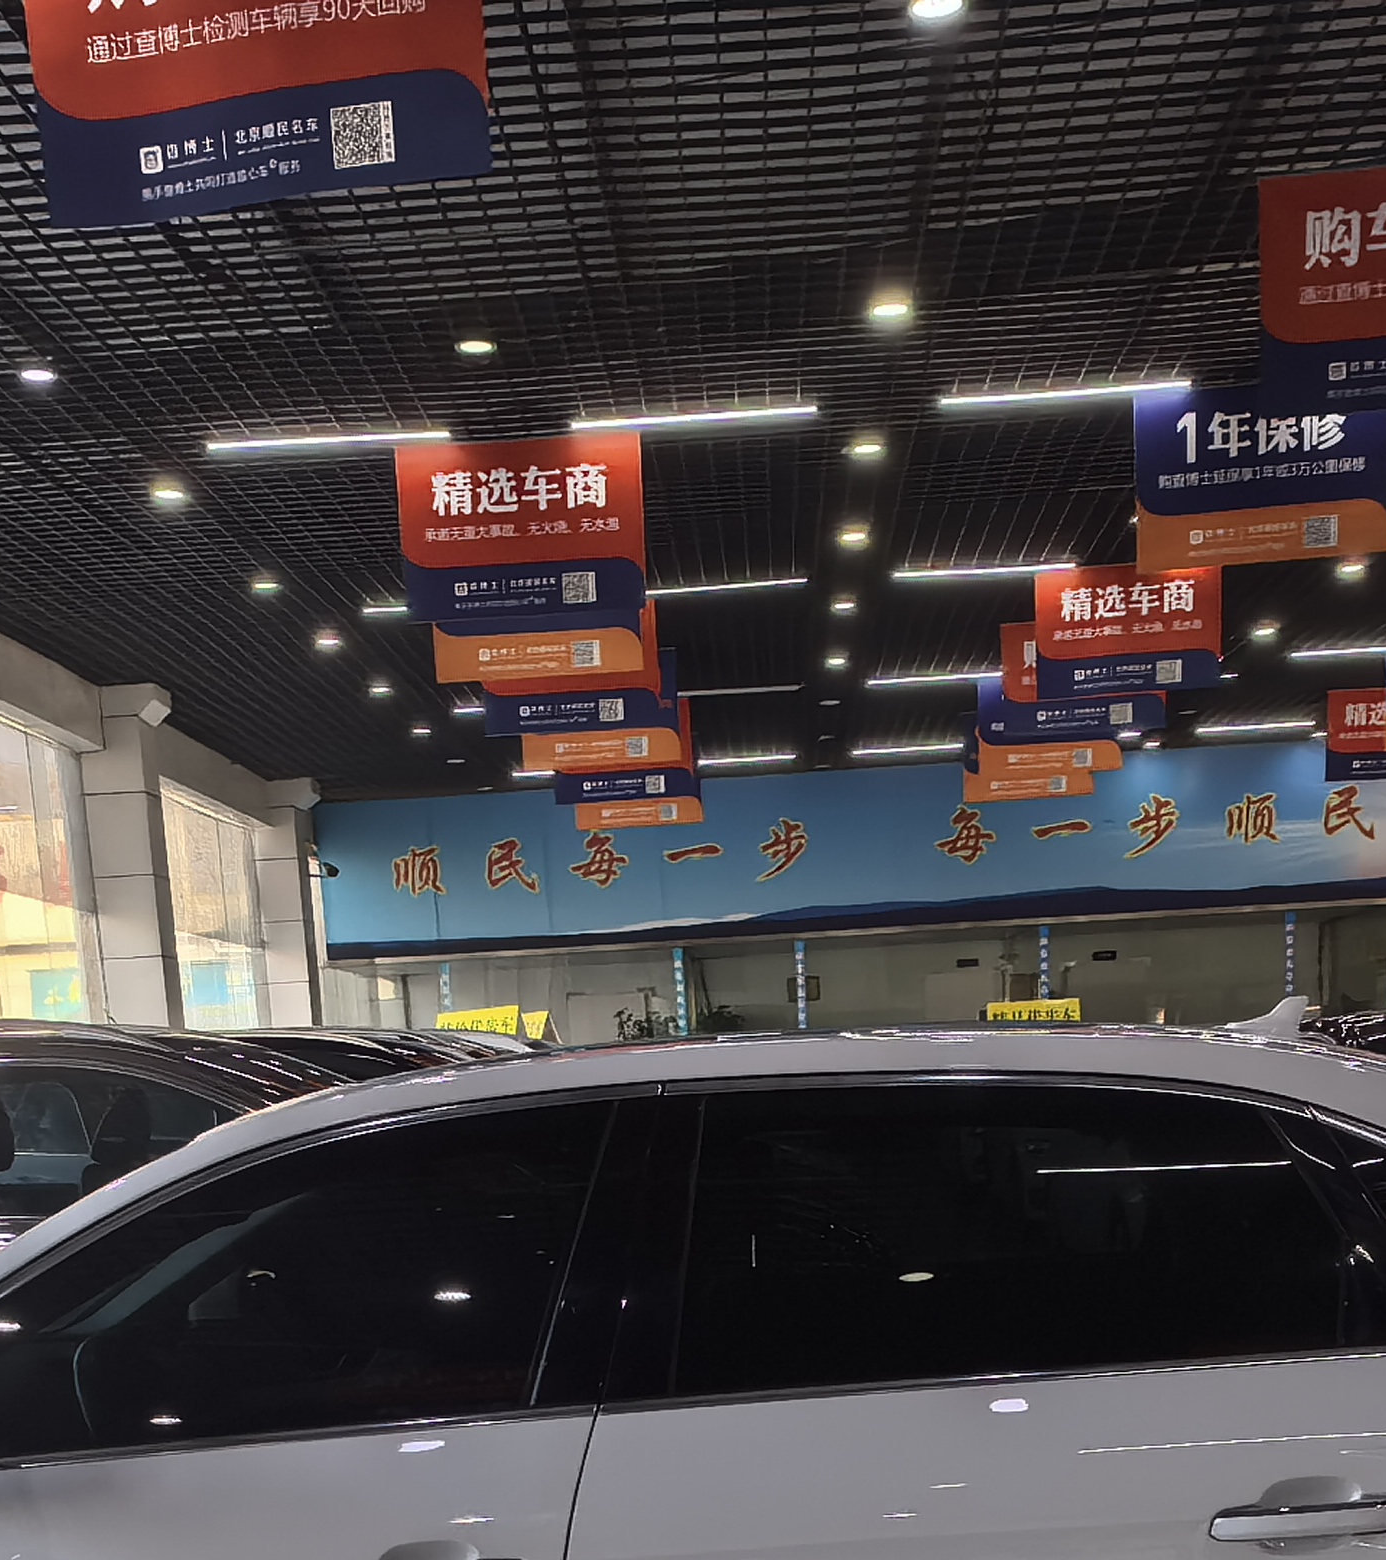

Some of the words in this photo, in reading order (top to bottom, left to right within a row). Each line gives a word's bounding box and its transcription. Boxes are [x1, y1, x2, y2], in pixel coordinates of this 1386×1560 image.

[1176, 411, 1347, 464] 1年保修
[431, 463, 608, 517] 精选车商
[1061, 579, 1195, 622] 精选车商
[392, 818, 809, 897] 顺民每一步
[934, 784, 1375, 865] 每一步顺民
